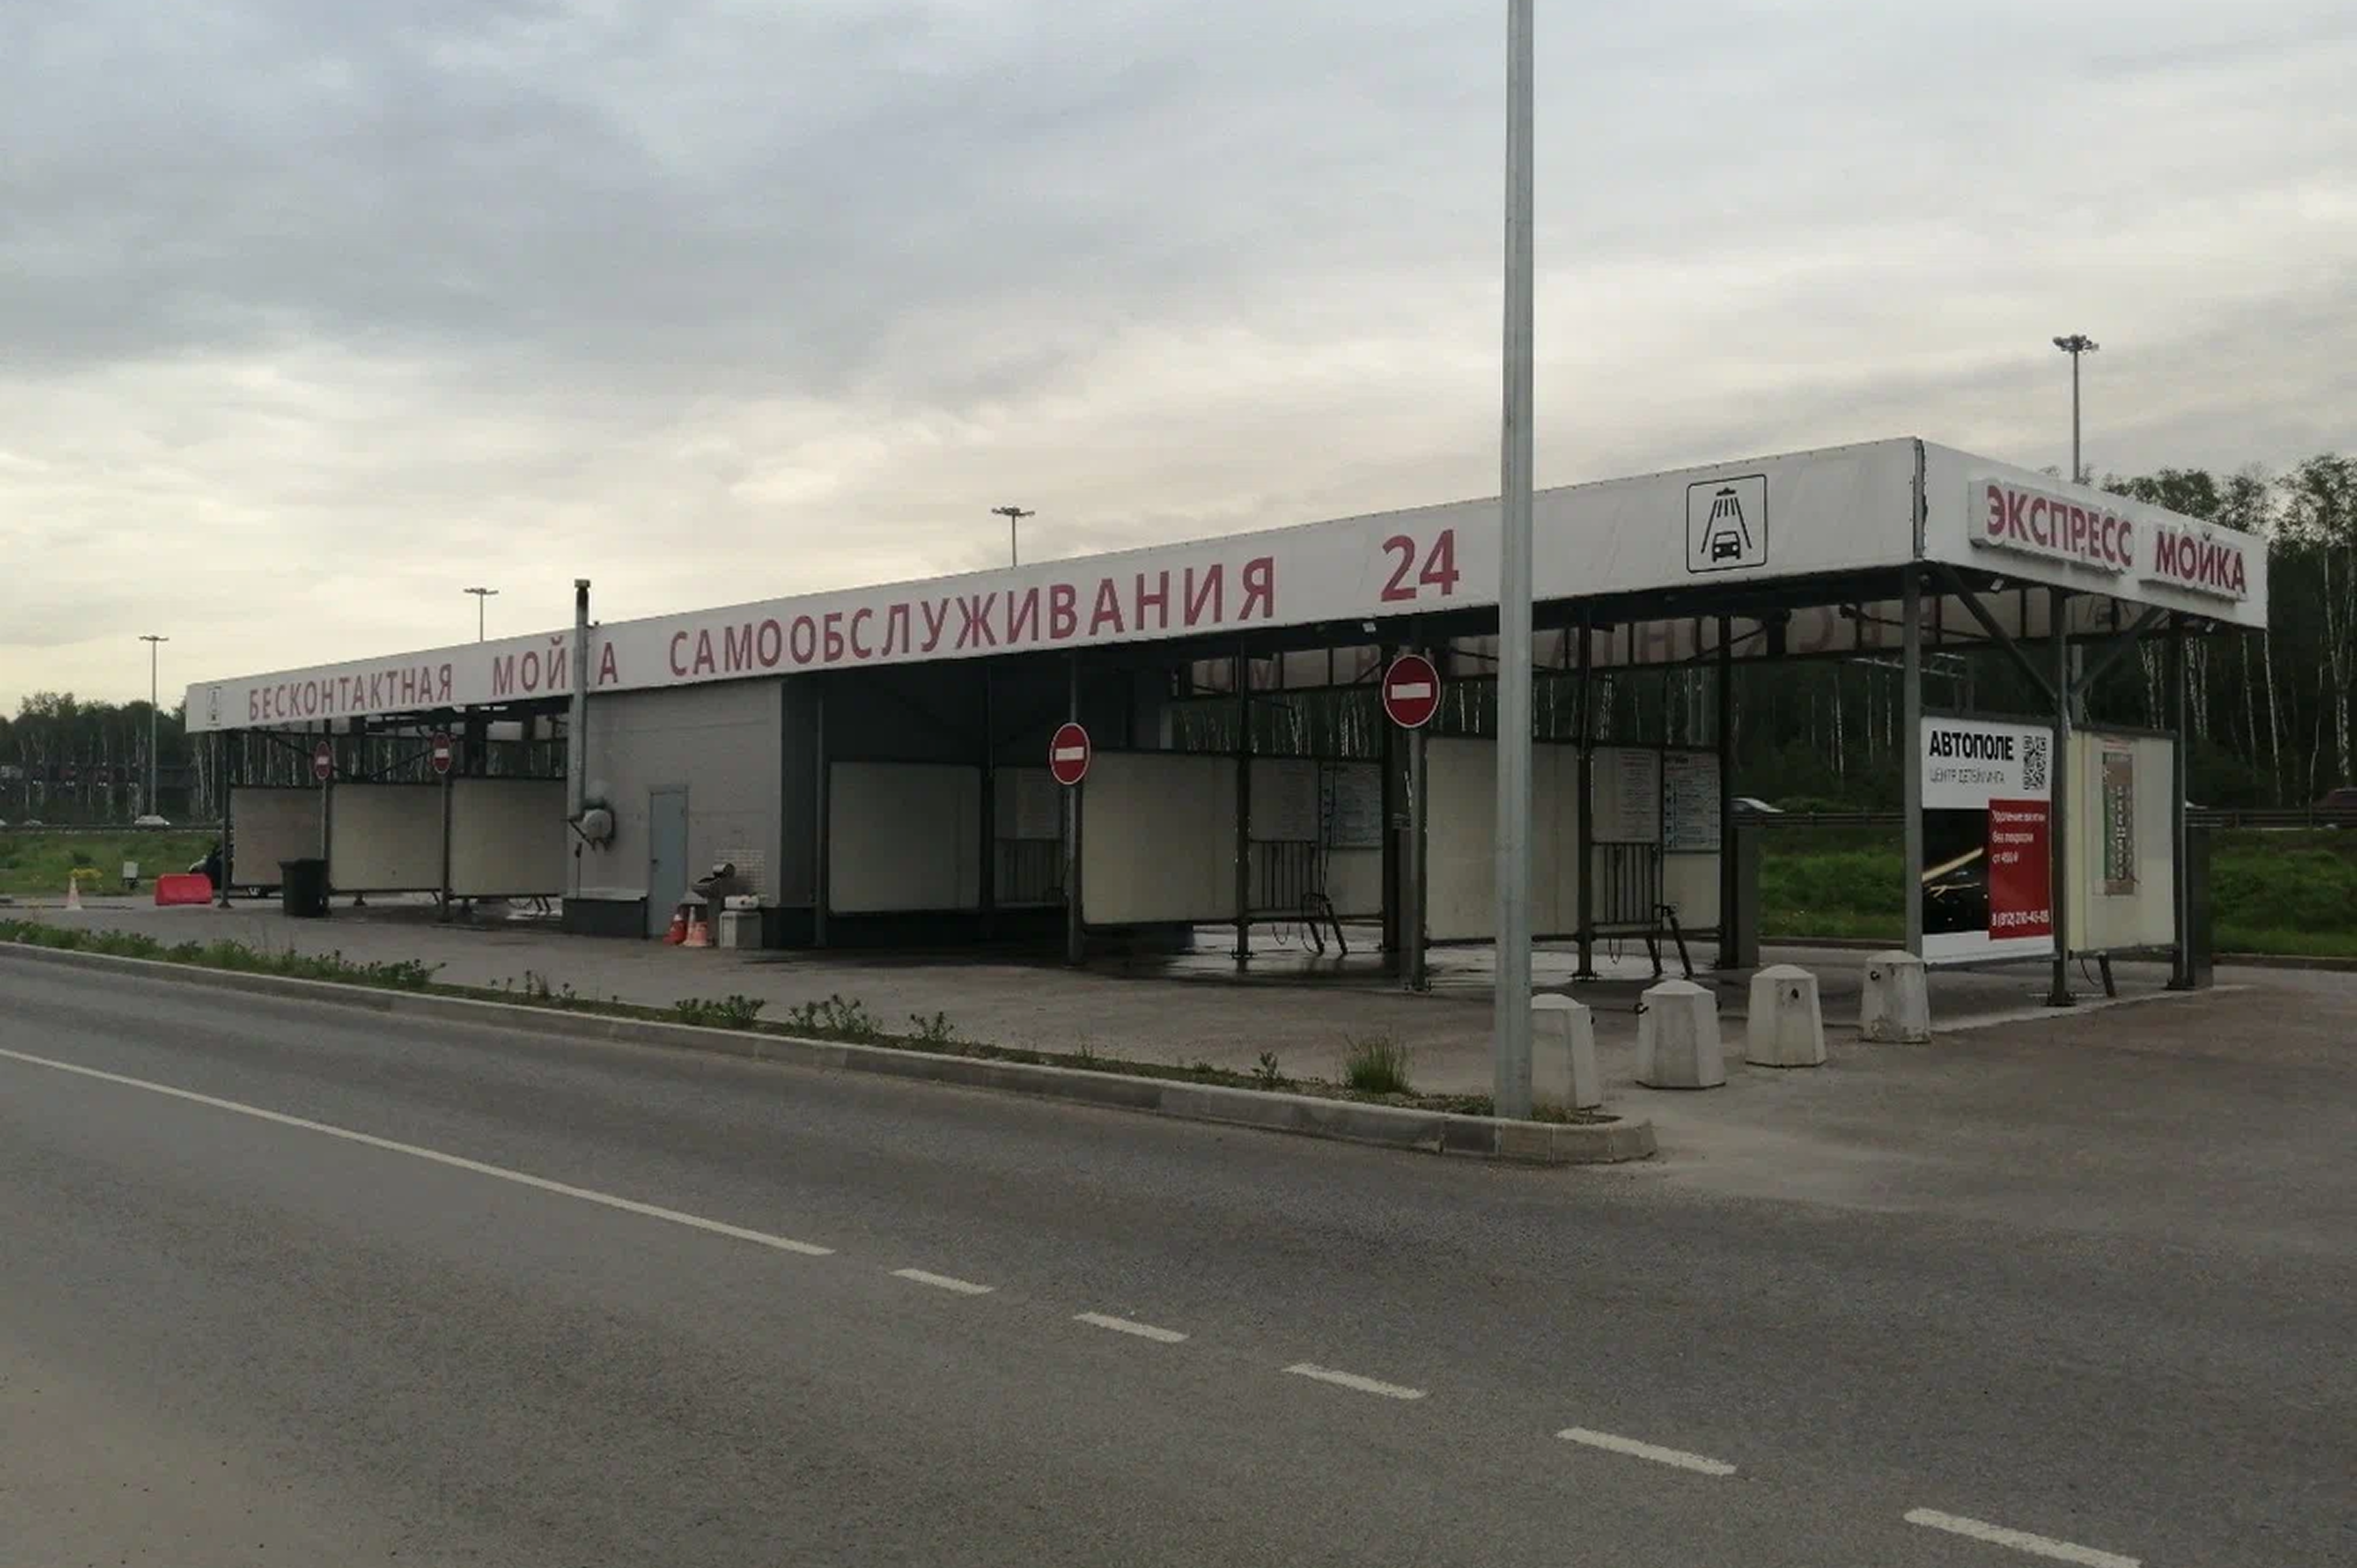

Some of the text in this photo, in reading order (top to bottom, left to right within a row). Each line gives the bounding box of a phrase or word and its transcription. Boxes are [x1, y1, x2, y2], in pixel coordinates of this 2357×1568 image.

[1986, 485, 2247, 593] ЭКСПРЕСС МОЙКА
[249, 663, 452, 721] БЕСКОНТАКТНАЯ
[493, 635, 618, 696] МОЙА
[670, 556, 1274, 677] САМООБСЛУЖИВАНИЯ
[1381, 529, 1459, 602] 24
[1929, 730, 2014, 761] АВТОПОЛЕ
